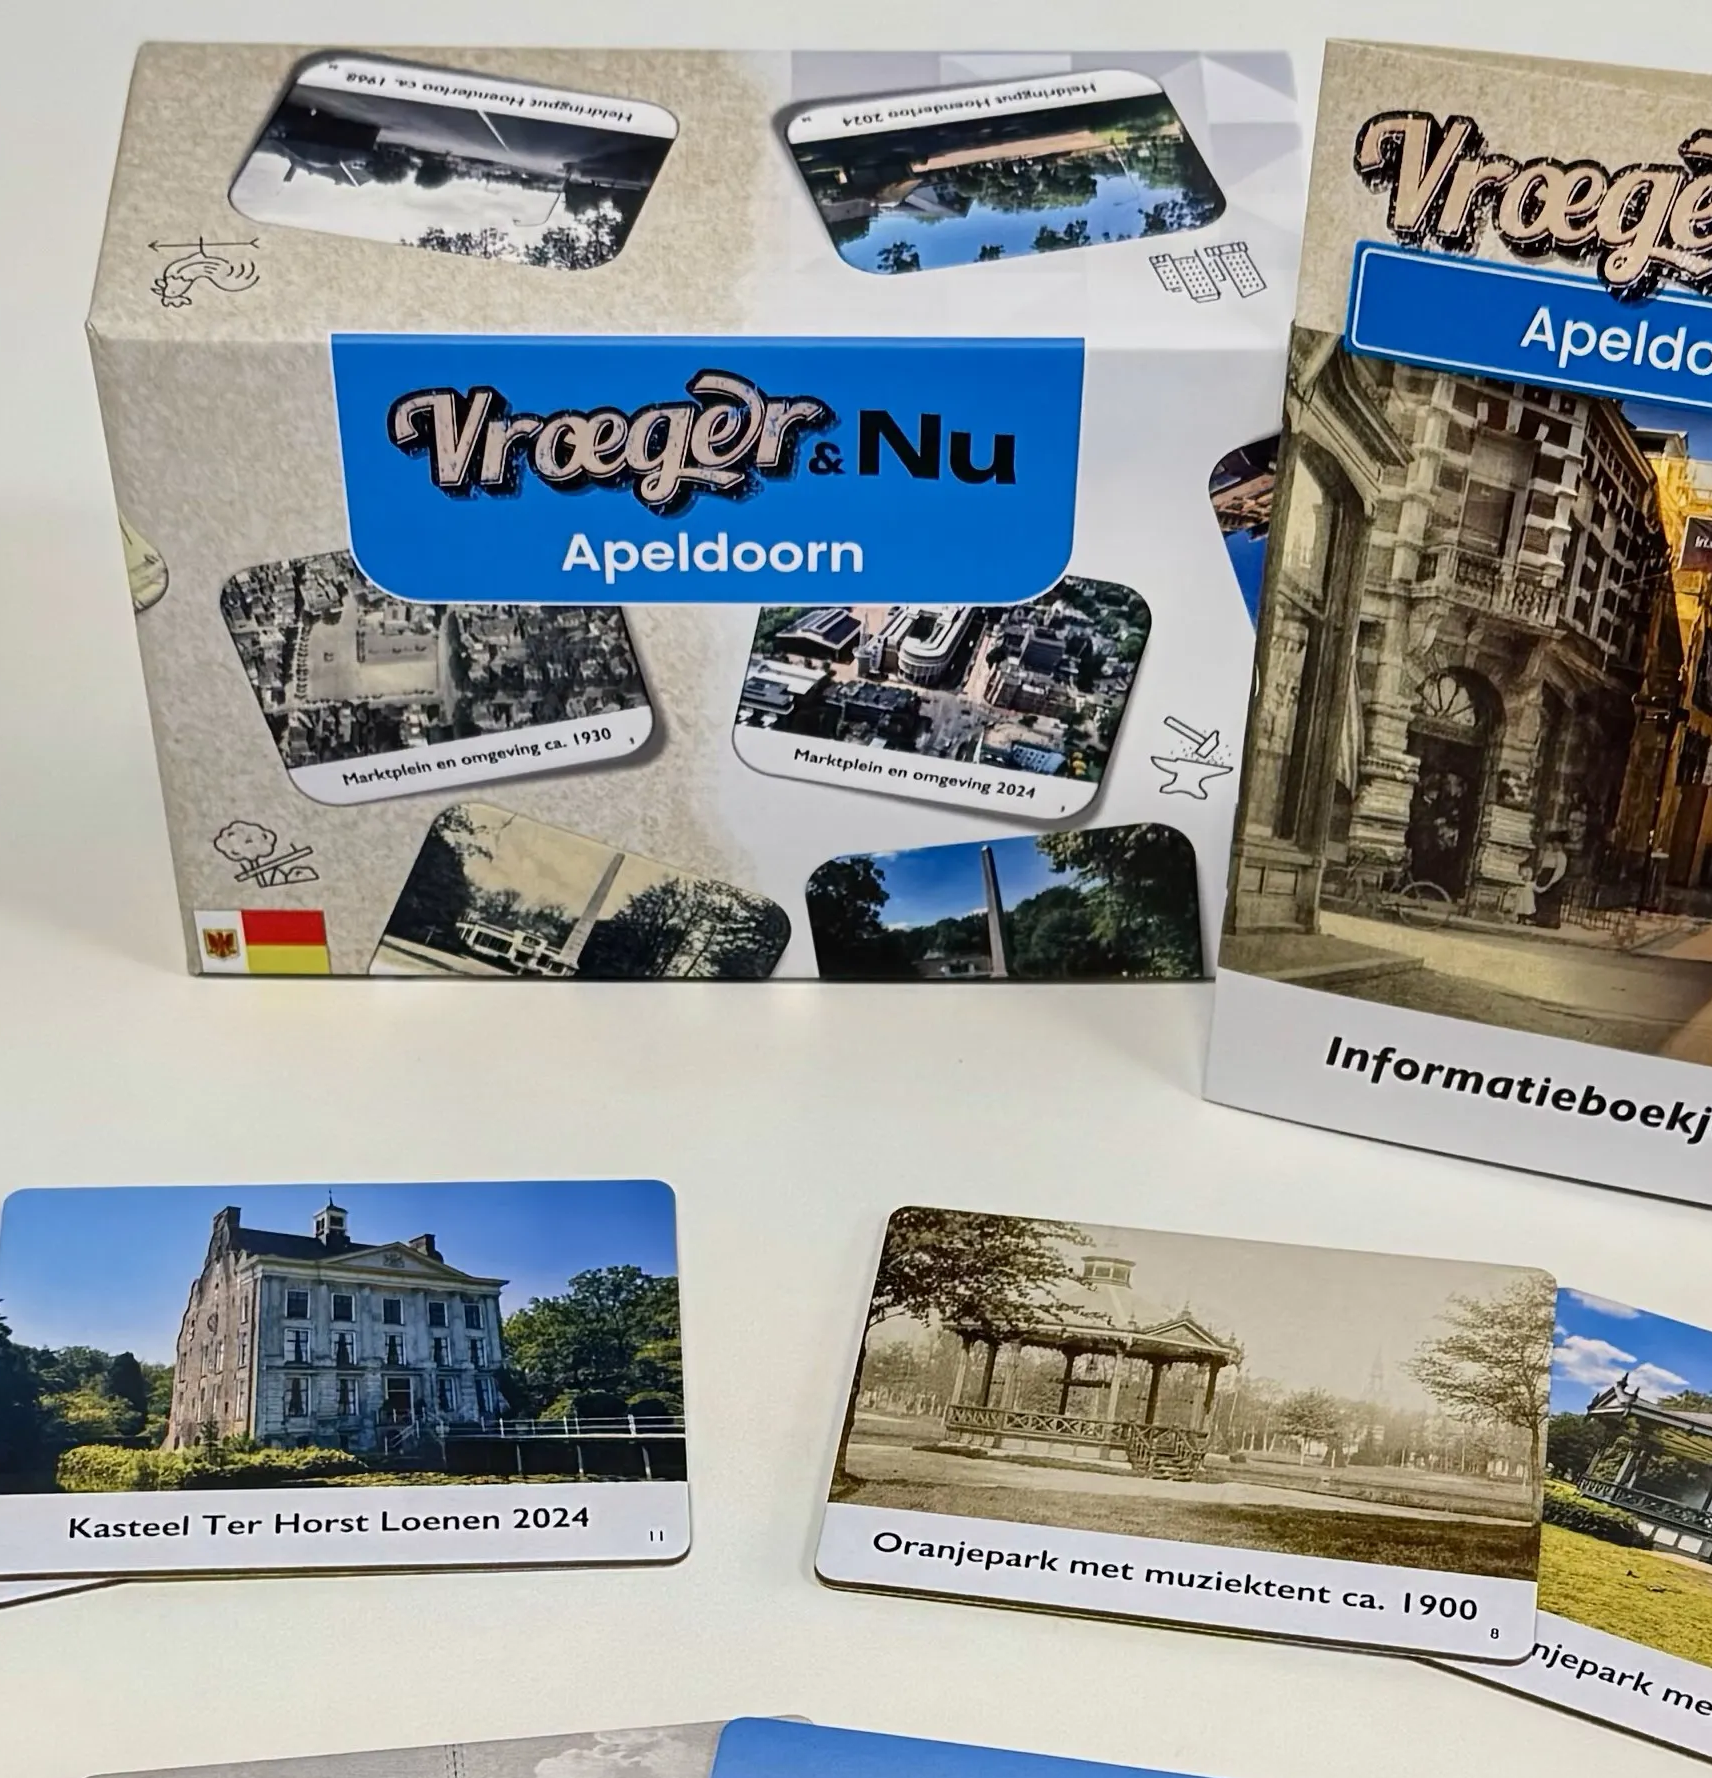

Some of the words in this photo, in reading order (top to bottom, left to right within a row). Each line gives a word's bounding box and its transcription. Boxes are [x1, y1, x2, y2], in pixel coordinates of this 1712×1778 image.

[396, 79, 417, 88] ca.
[422, 83, 524, 108] Hoenderloo
[995, 80, 1097, 104] Heldringput
[531, 97, 633, 122] Heldringput
[842, 113, 884, 126] 2024
[888, 95, 991, 119] Hoenderloo
[808, 442, 847, 477] &
[858, 412, 1016, 486] Nu
[562, 531, 864, 583] Apeldoorn
[343, 762, 431, 785] Marktplein
[437, 759, 456, 769] en
[462, 745, 540, 765] omgeving
[545, 741, 566, 750] ca.
[574, 728, 611, 744] 1930
[795, 749, 882, 773] Marktplein
[888, 769, 907, 777] en
[914, 772, 991, 794] omgeving
[997, 782, 1035, 798] 2024
[70, 1516, 188, 1538] Kasteel
[203, 1515, 262, 1535] Ter
[276, 1513, 368, 1533] Horst
[382, 1512, 499, 1531] Loenen
[514, 1508, 588, 1528] 2024
[874, 1533, 1058, 1571] Oranjepark
[1070, 1560, 1133, 1580] met
[1146, 1569, 1330, 1603] muziektent
[1343, 1593, 1384, 1610] ca.
[1405, 1593, 1477, 1620] 1900
[1490, 1627, 1499, 1640] 8
